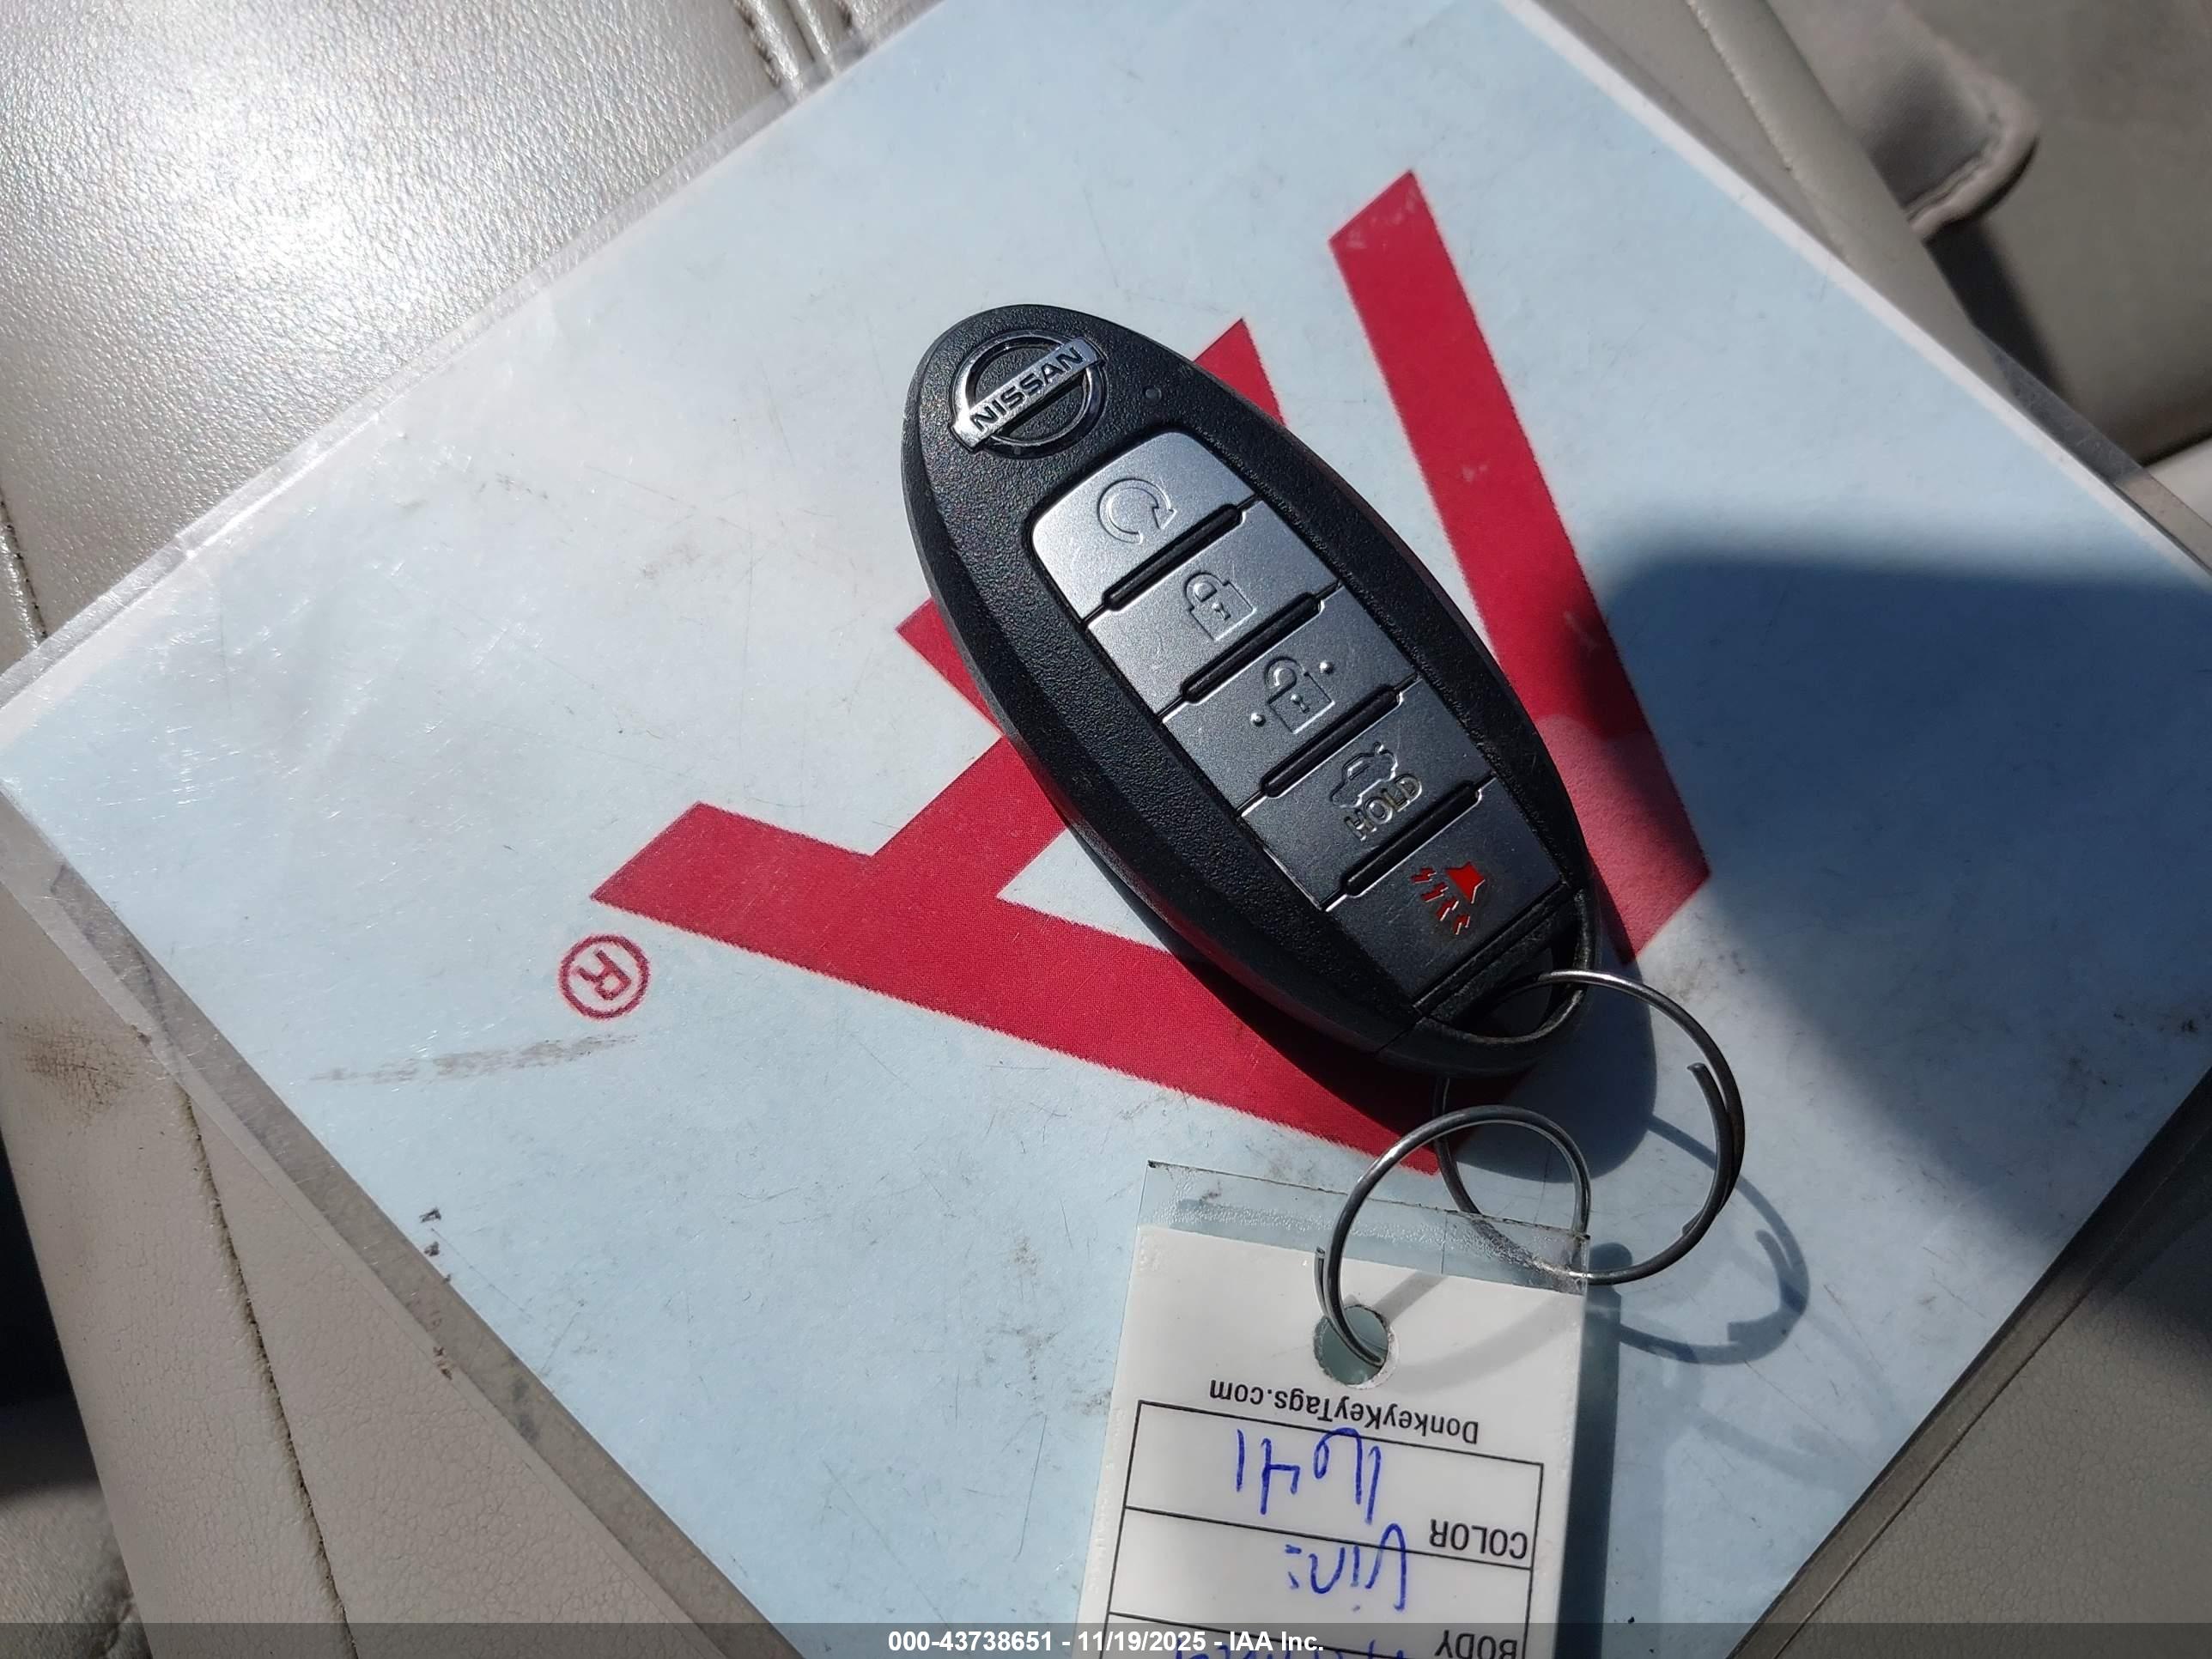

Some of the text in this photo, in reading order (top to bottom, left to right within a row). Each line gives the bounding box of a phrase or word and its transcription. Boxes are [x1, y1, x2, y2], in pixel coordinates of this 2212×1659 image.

[969, 346, 1085, 433] NISSAN
[1344, 774, 1422, 842] HOLD
[1209, 1379, 1480, 1445] DonkeyKeyTags.com
[1235, 1427, 1382, 1525] 1641
[1430, 1519, 1528, 1559] COLOR
[1435, 1630, 1518, 1659] BODY
